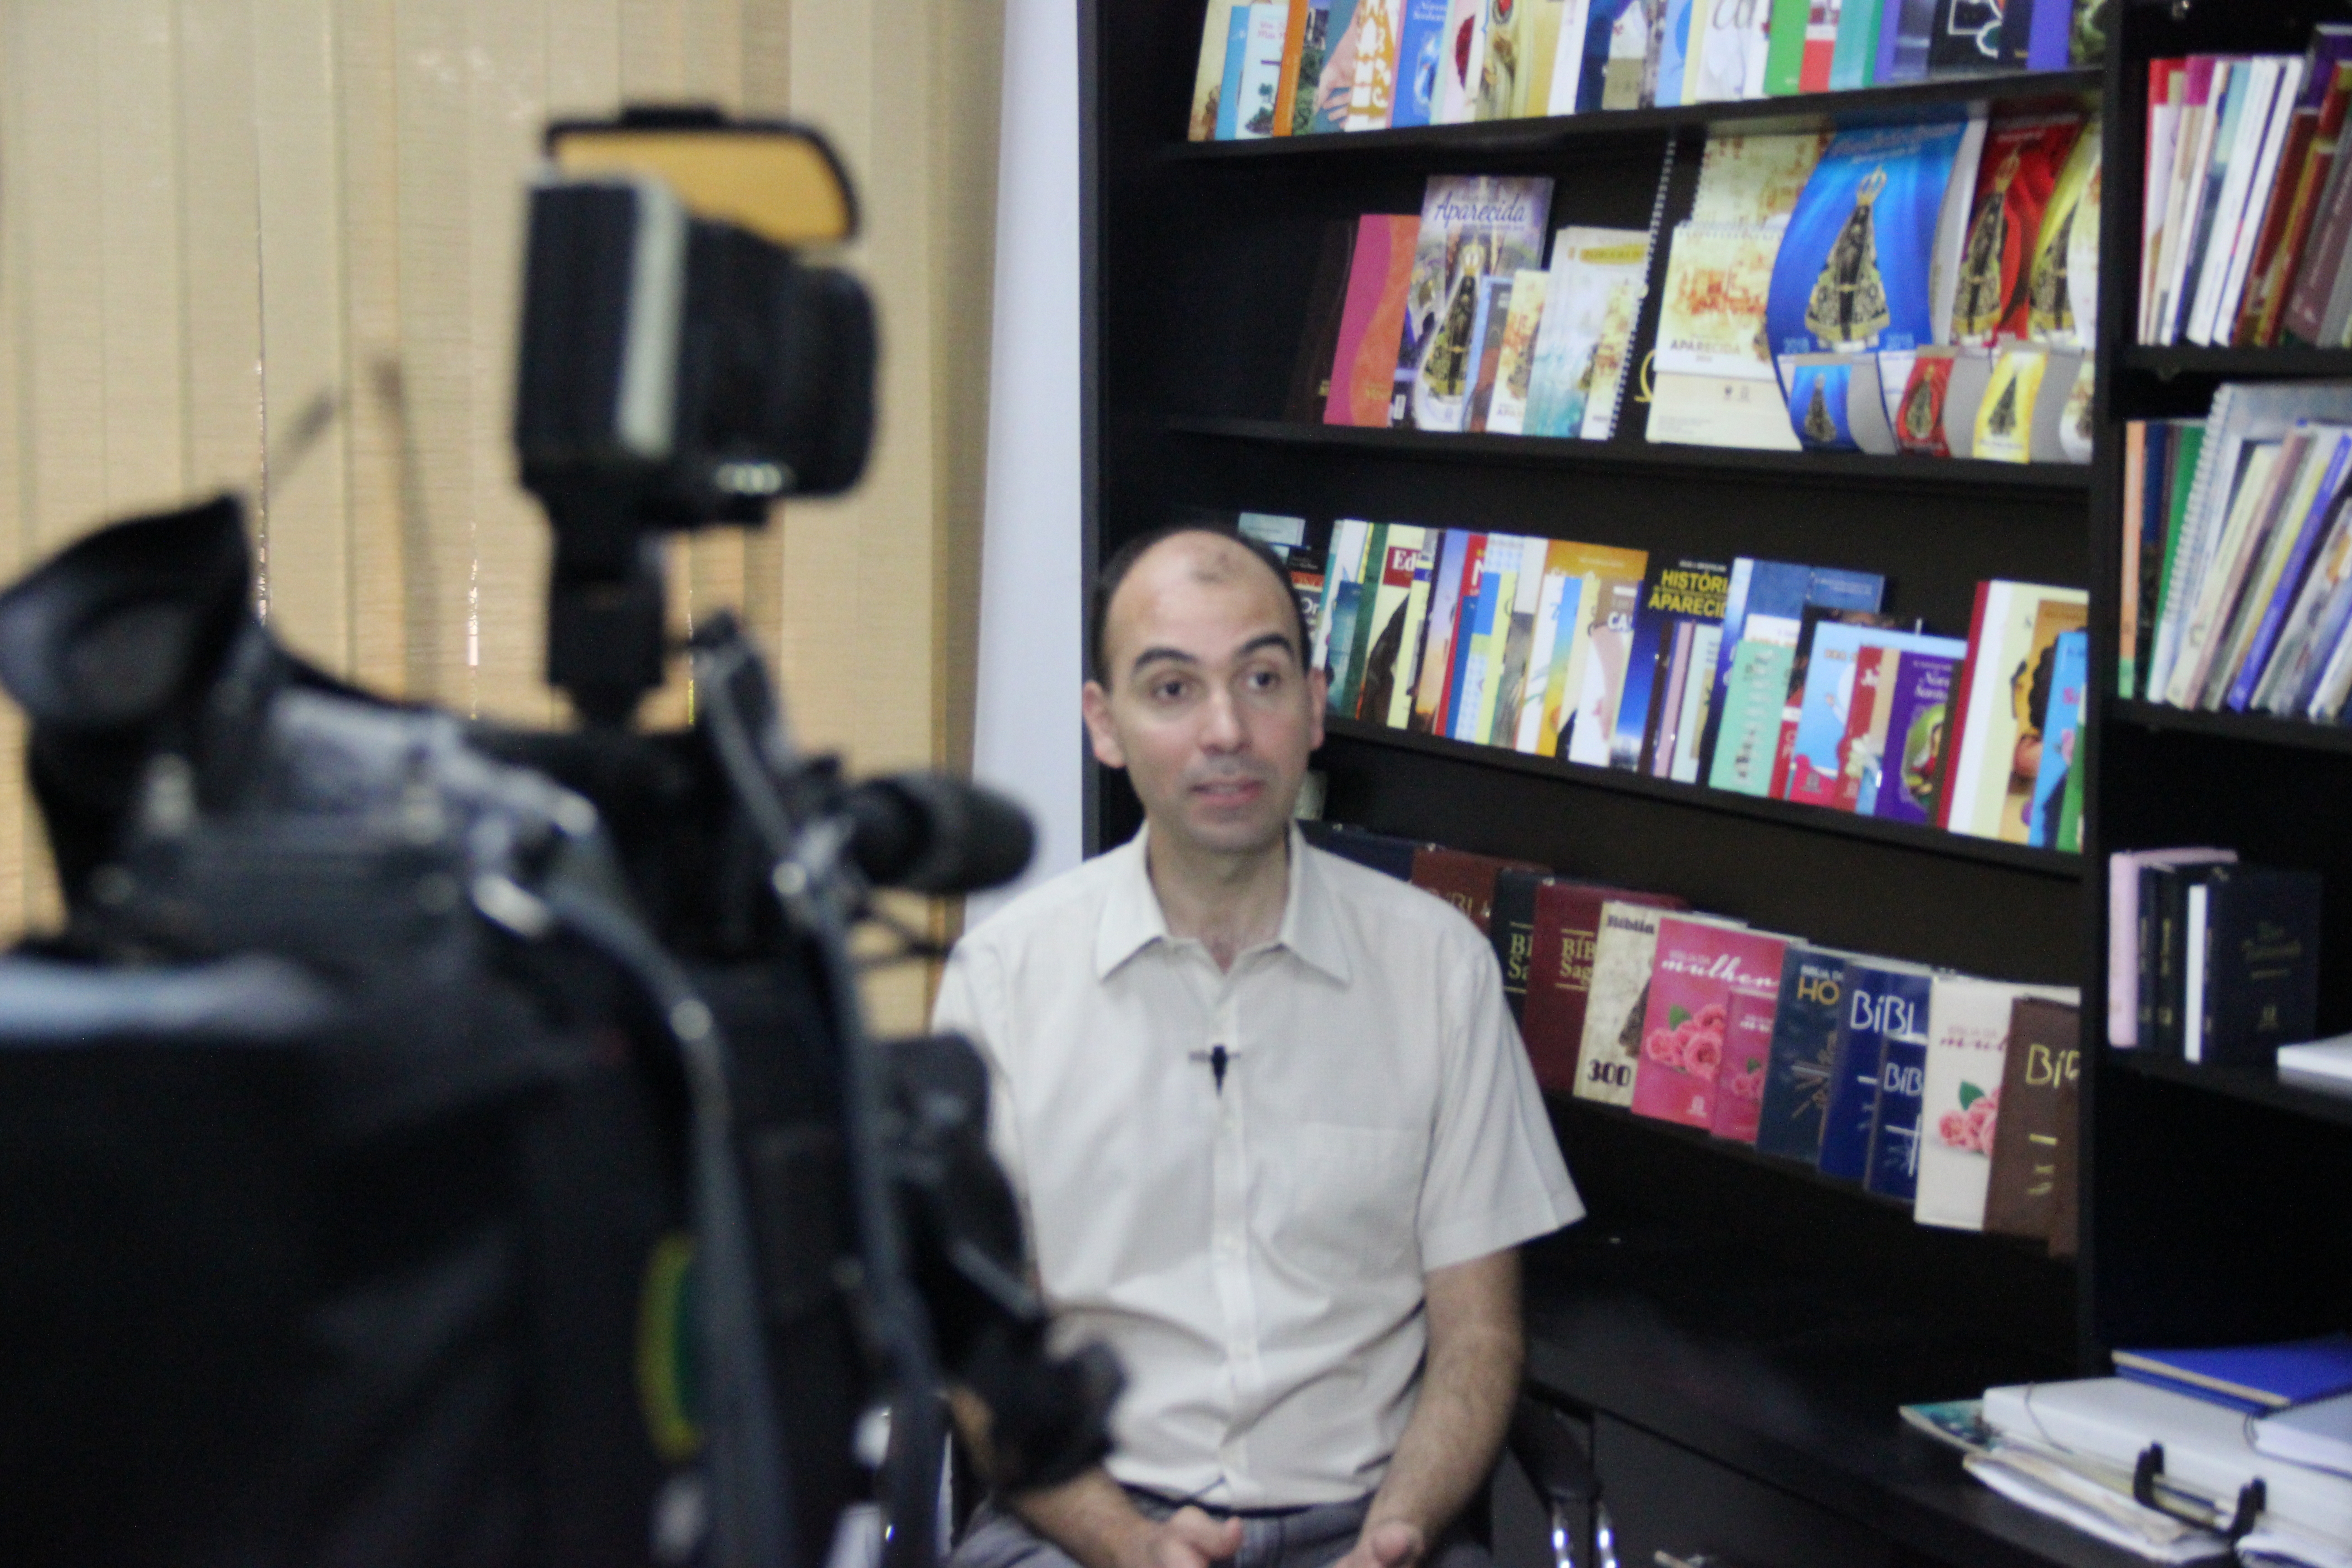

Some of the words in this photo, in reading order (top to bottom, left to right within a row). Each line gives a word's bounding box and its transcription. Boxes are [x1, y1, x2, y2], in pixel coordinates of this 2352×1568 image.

[1434, 190, 1527, 229] Aparecida
[1607, 612, 1634, 630] CA
[1588, 1059, 1631, 1086] 300
